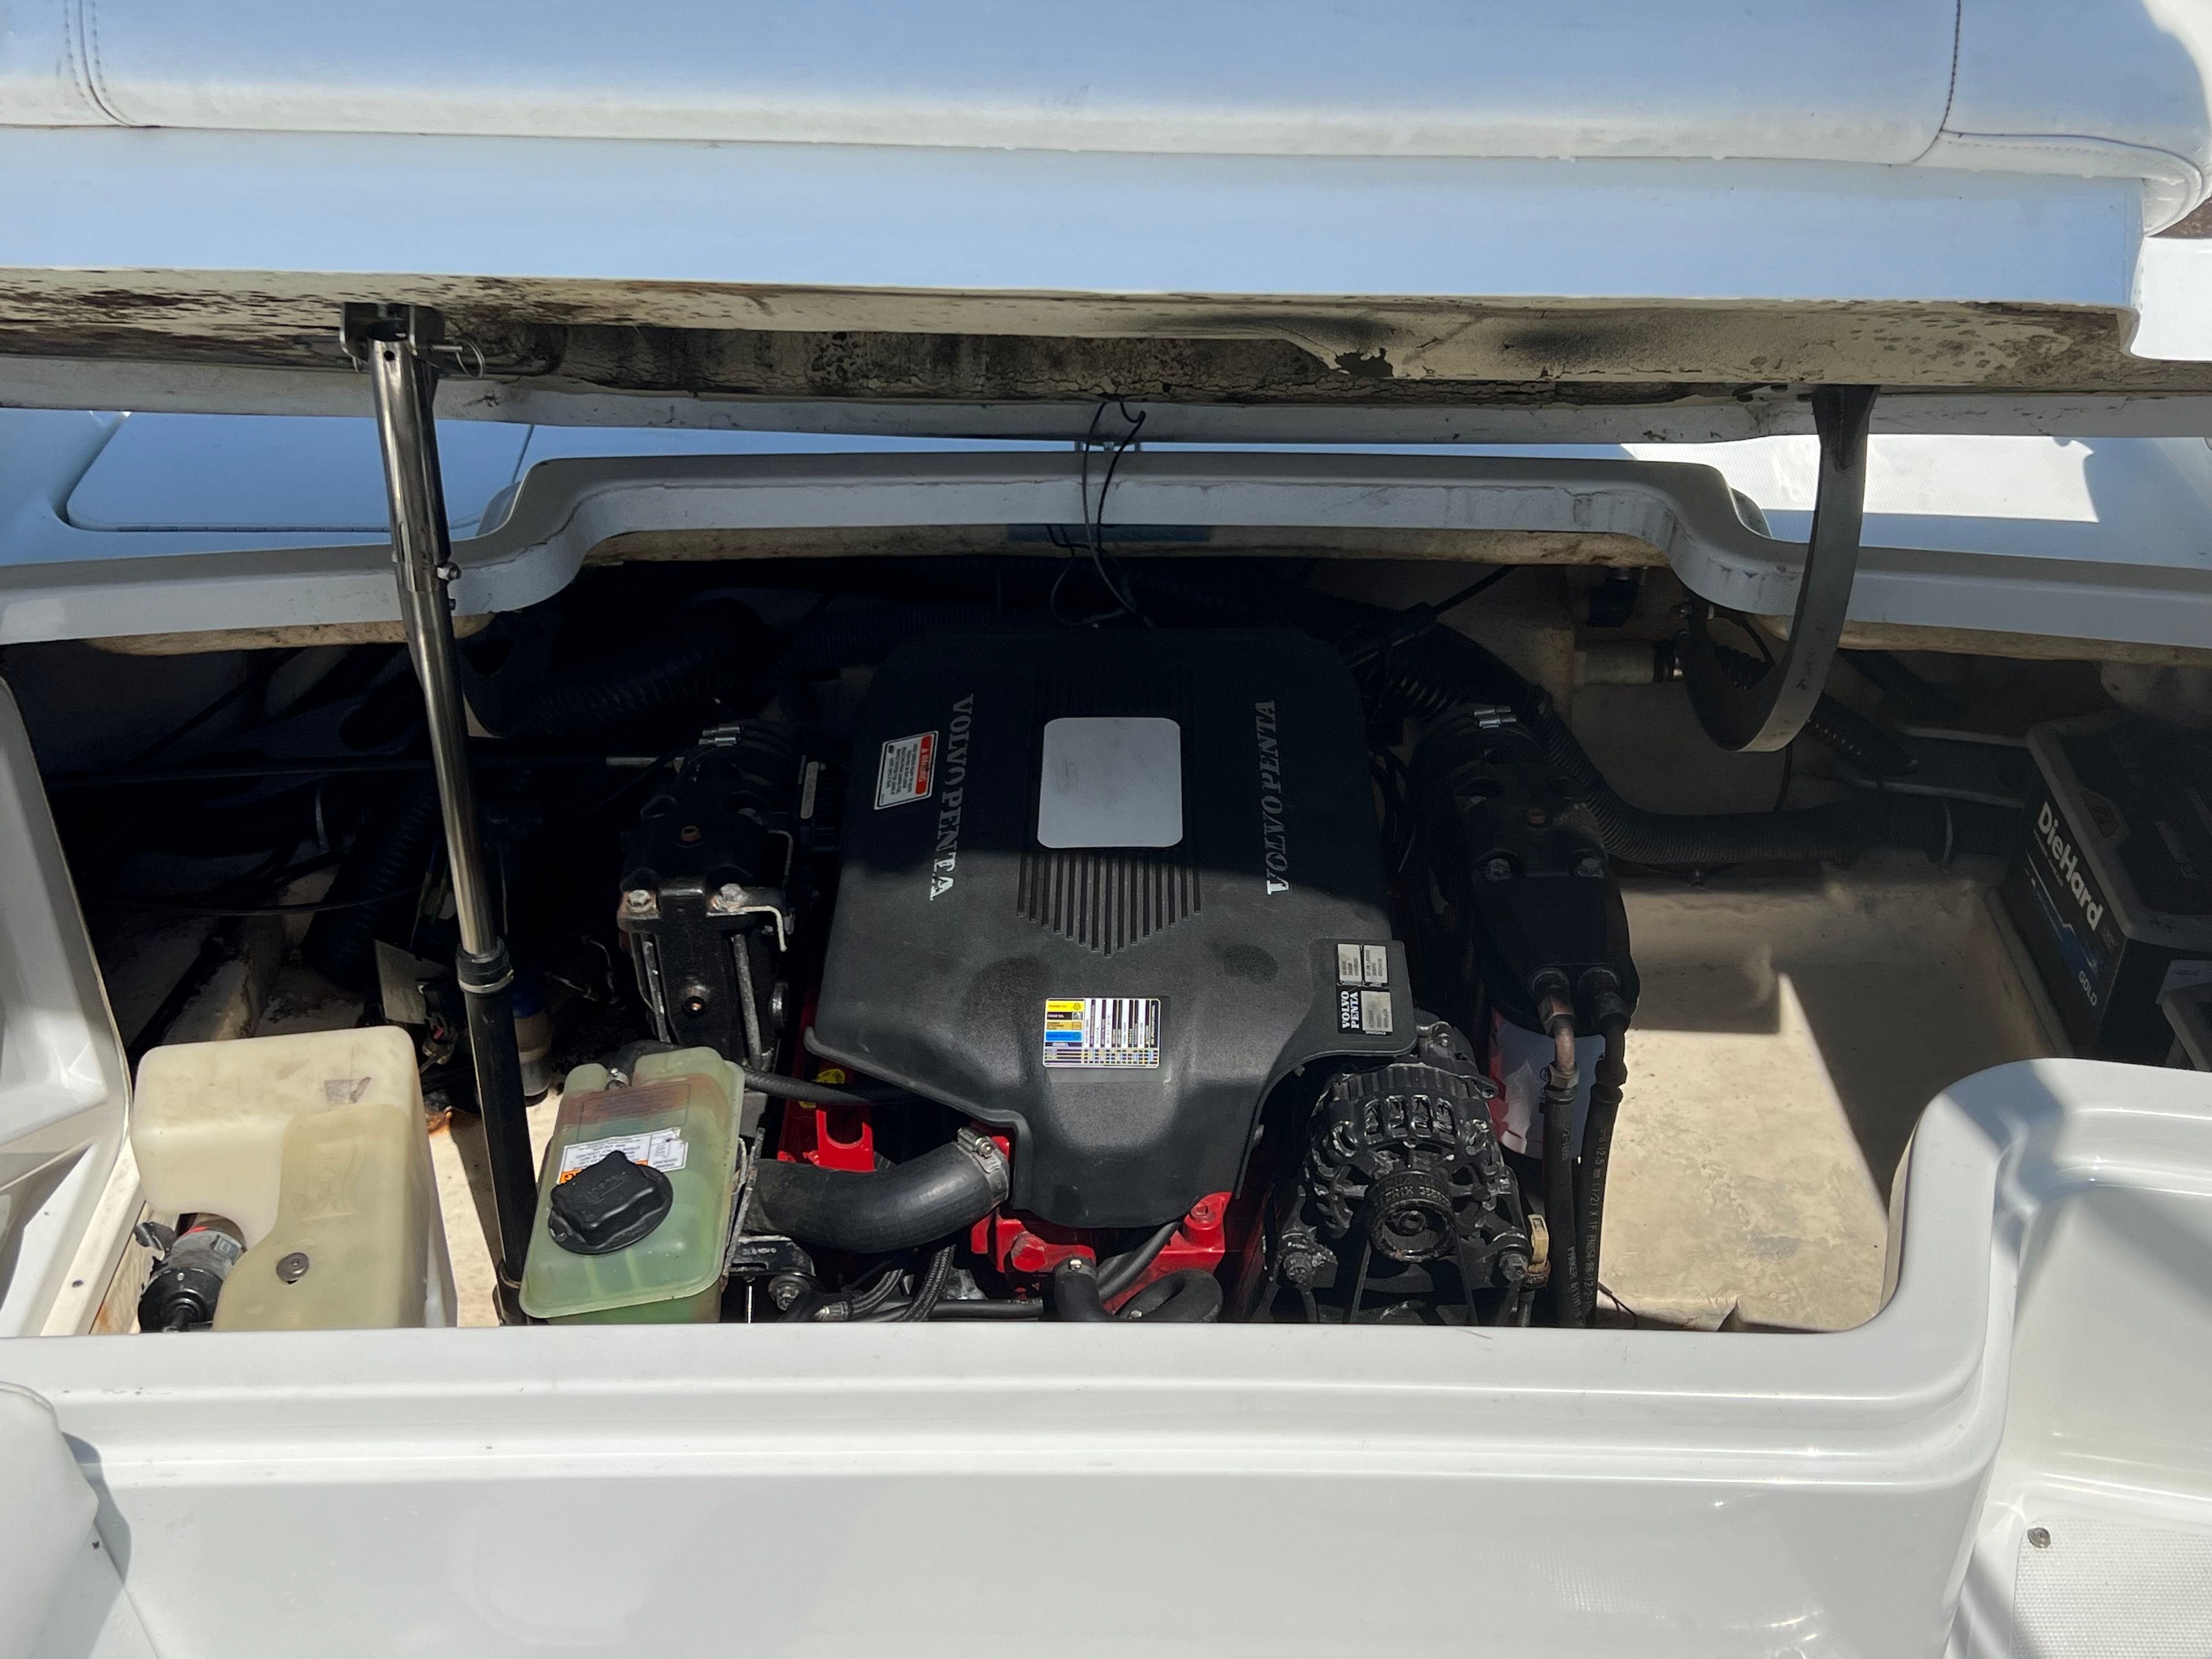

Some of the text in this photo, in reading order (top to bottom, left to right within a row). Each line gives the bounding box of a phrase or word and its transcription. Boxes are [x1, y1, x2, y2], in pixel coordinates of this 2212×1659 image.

[930, 693, 974, 901] VOLVO PENTA
[1255, 699, 1289, 895] VOLVO PENTA
[2037, 800, 2103, 932] DieHard
[1340, 990, 1351, 1029] VOLVO
[1350, 991, 1359, 1029] PENTA
[2078, 970, 2097, 1006] GOLD
